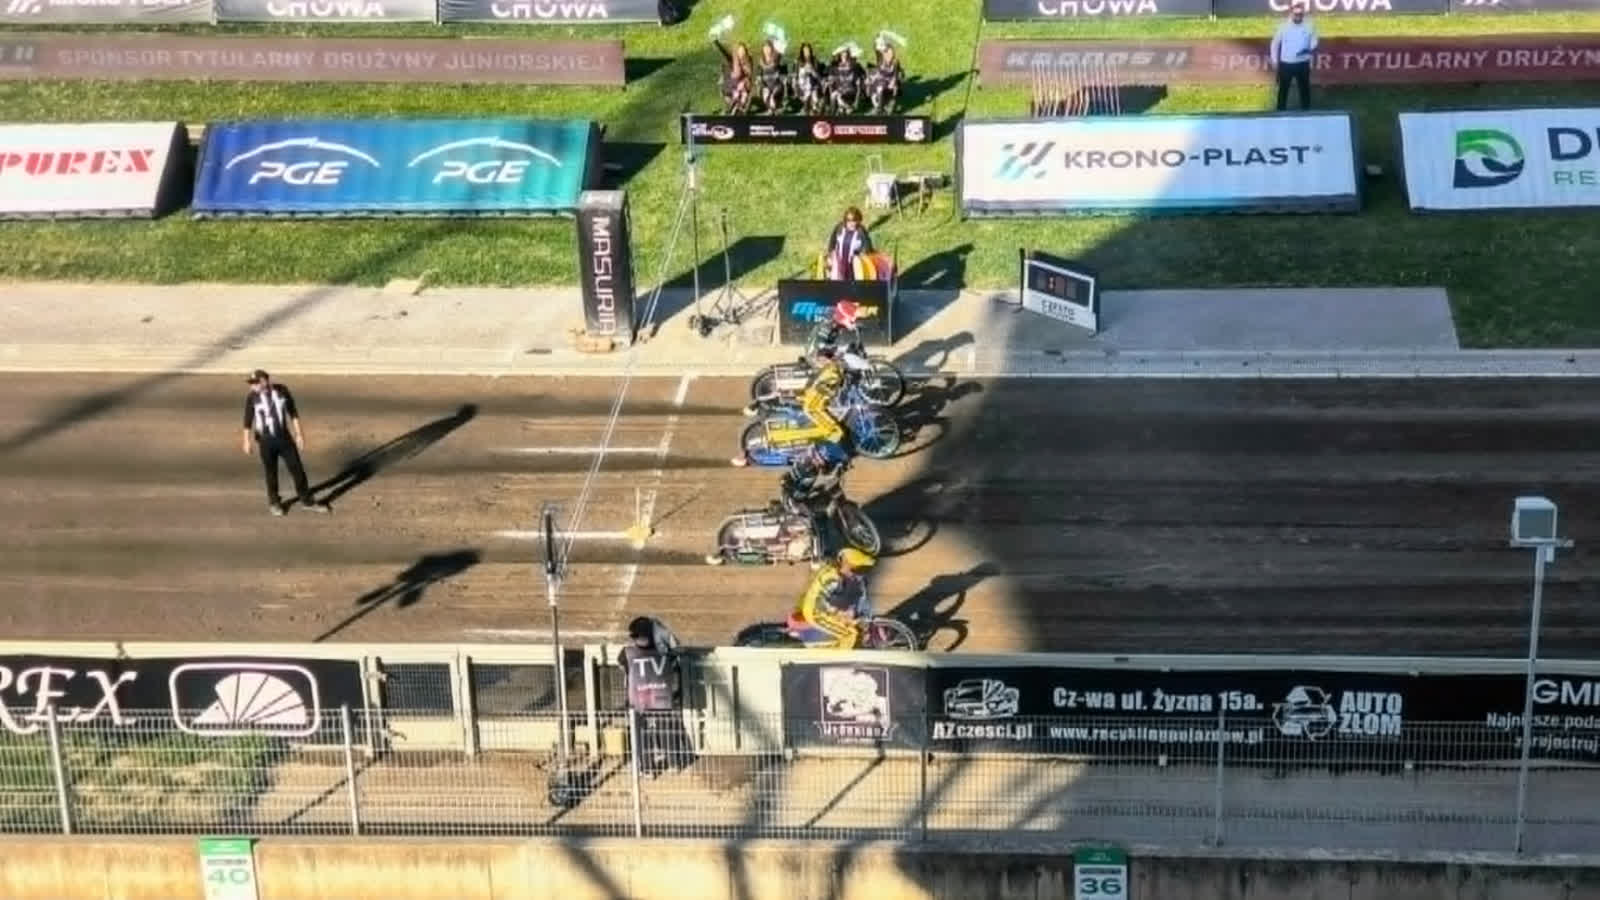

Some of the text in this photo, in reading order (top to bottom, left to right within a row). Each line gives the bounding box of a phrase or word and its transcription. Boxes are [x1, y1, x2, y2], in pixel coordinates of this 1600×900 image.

[57, 49, 606, 72] SPONSOR TYTULARNY DRUŻYNY JUNIORSKIEJ
[1342, 50, 1489, 70] TYTULARNY
[249, 161, 349, 185] PGE
[432, 160, 531, 184] PGE
[633, 656, 667, 677] TV
[1053, 686, 1264, 712] Cz-wa ul. Żyzna 15a.
[1340, 690, 1402, 714] AUTO
[207, 868, 250, 885] 40
[1080, 877, 1121, 895] 36
